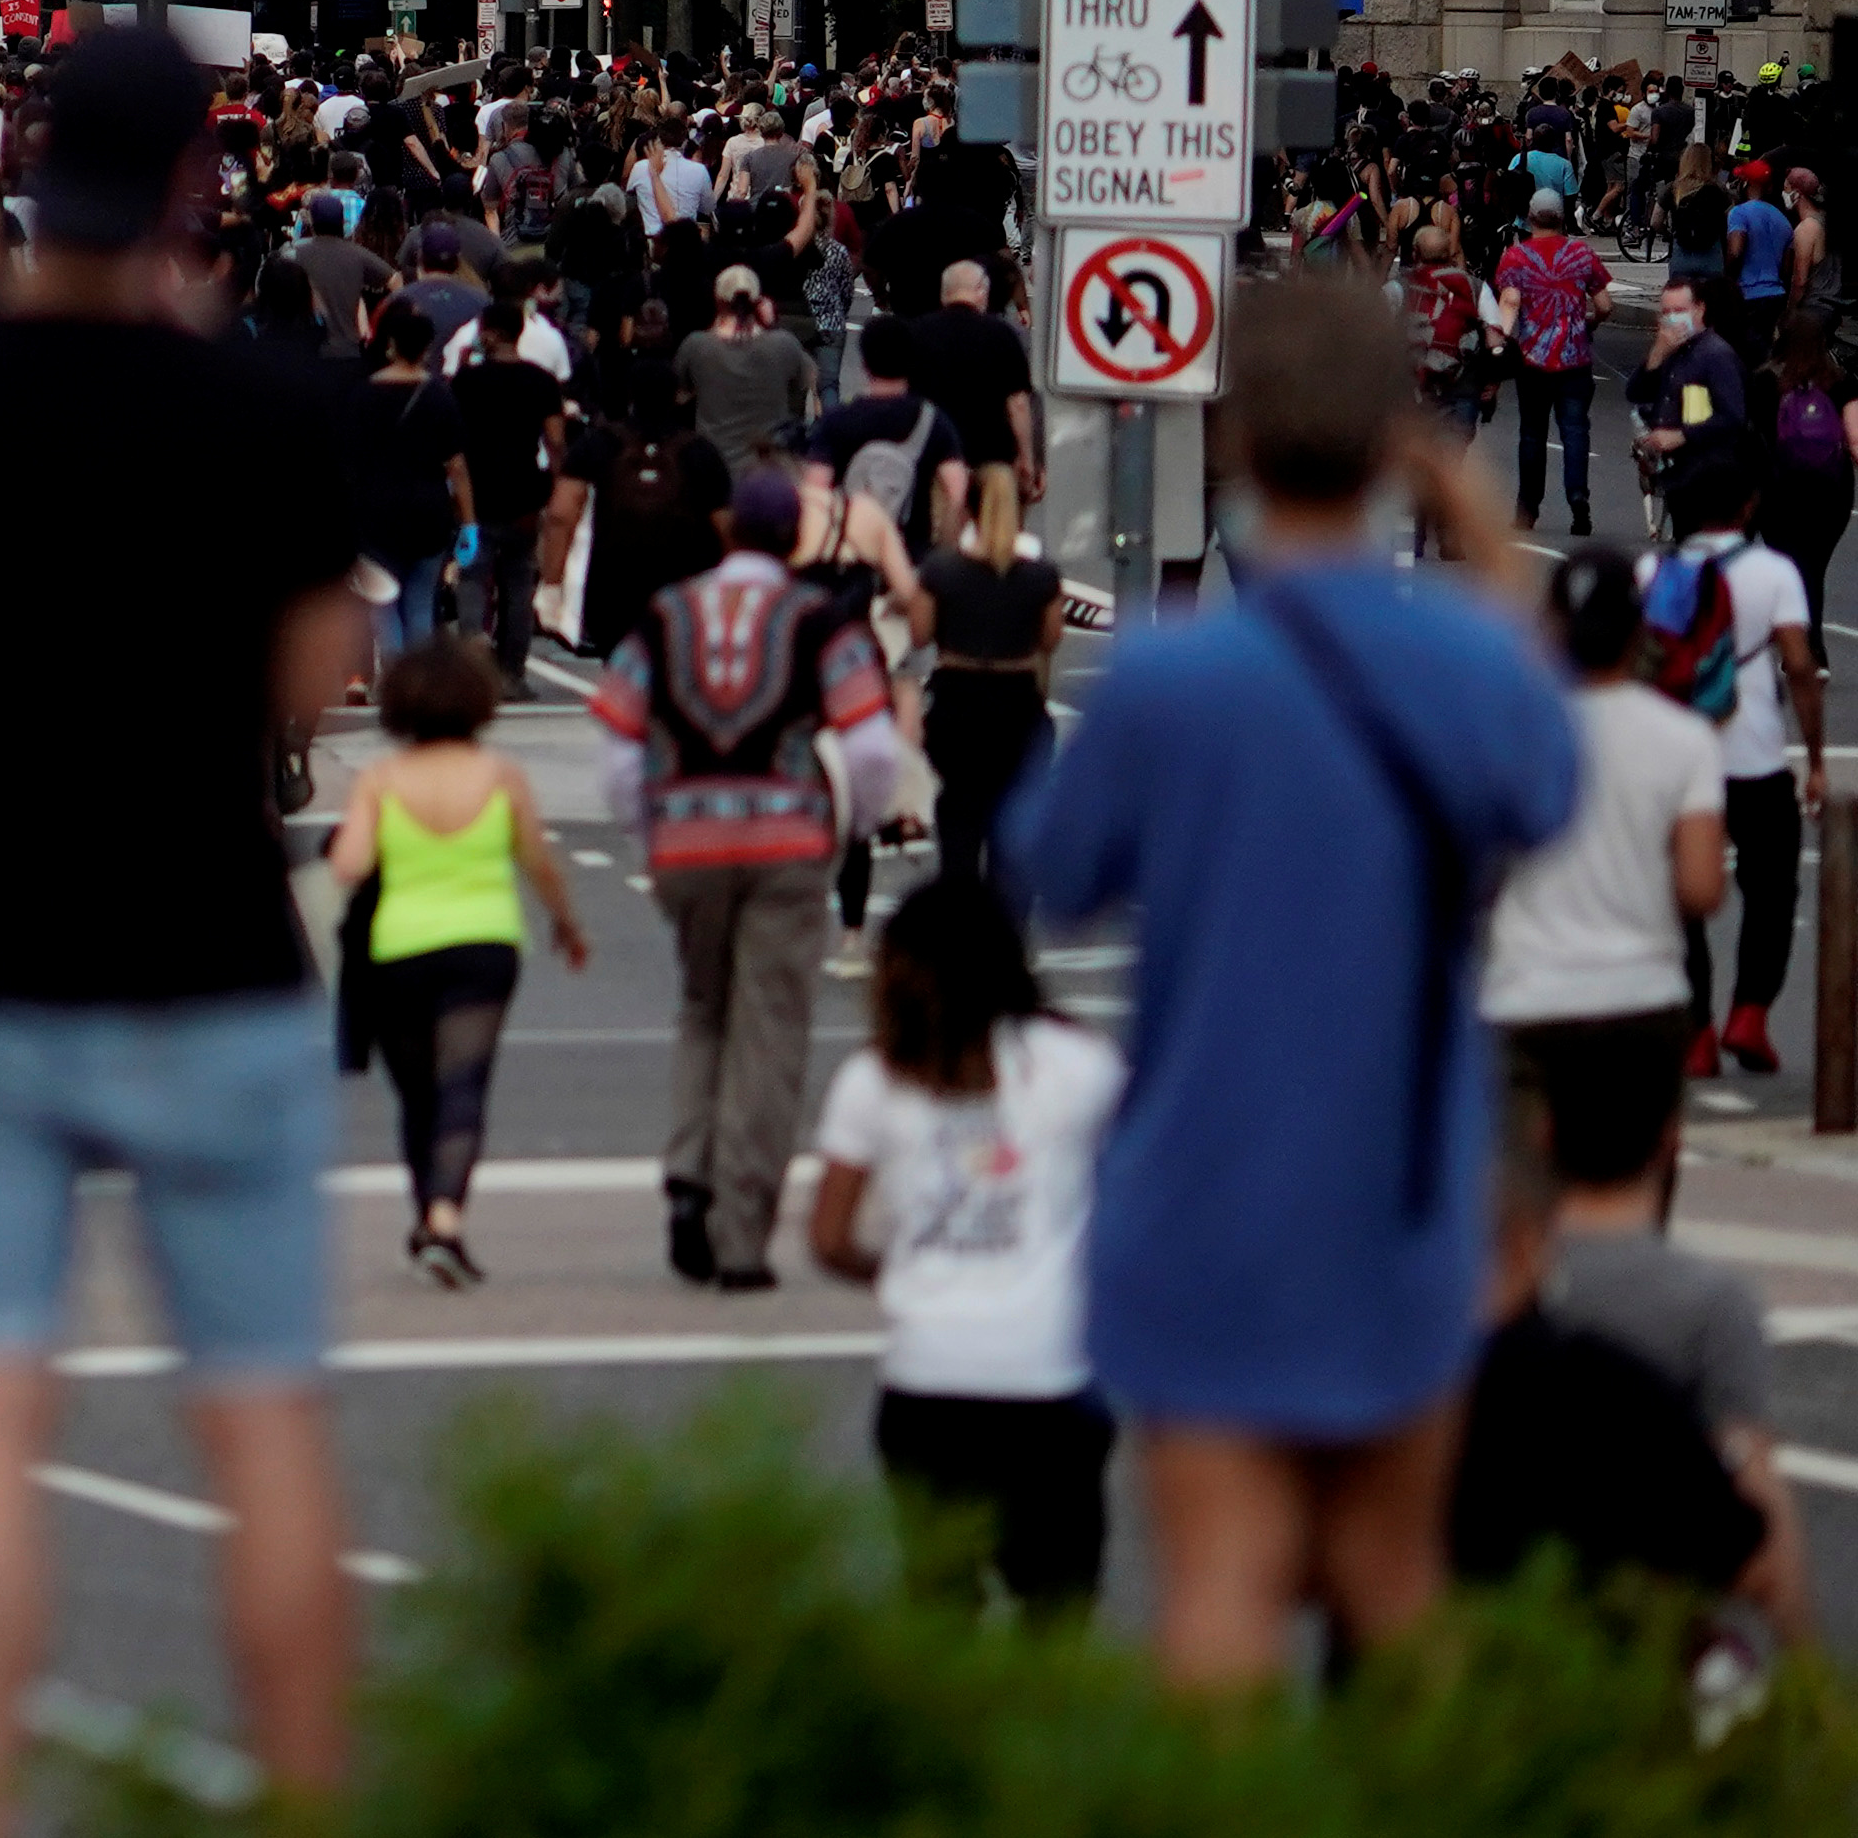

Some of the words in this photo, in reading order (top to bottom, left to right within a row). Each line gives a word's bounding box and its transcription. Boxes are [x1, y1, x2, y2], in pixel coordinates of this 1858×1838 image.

[8, 1, 20, 11] IS
[1668, 6, 1725, 20] 7AM-7PM
[3, 12, 39, 26] CONSENT
[1055, 118, 1145, 156] OBEY
[1164, 121, 1236, 160] THIS
[1054, 166, 1175, 205] SIGNAL
